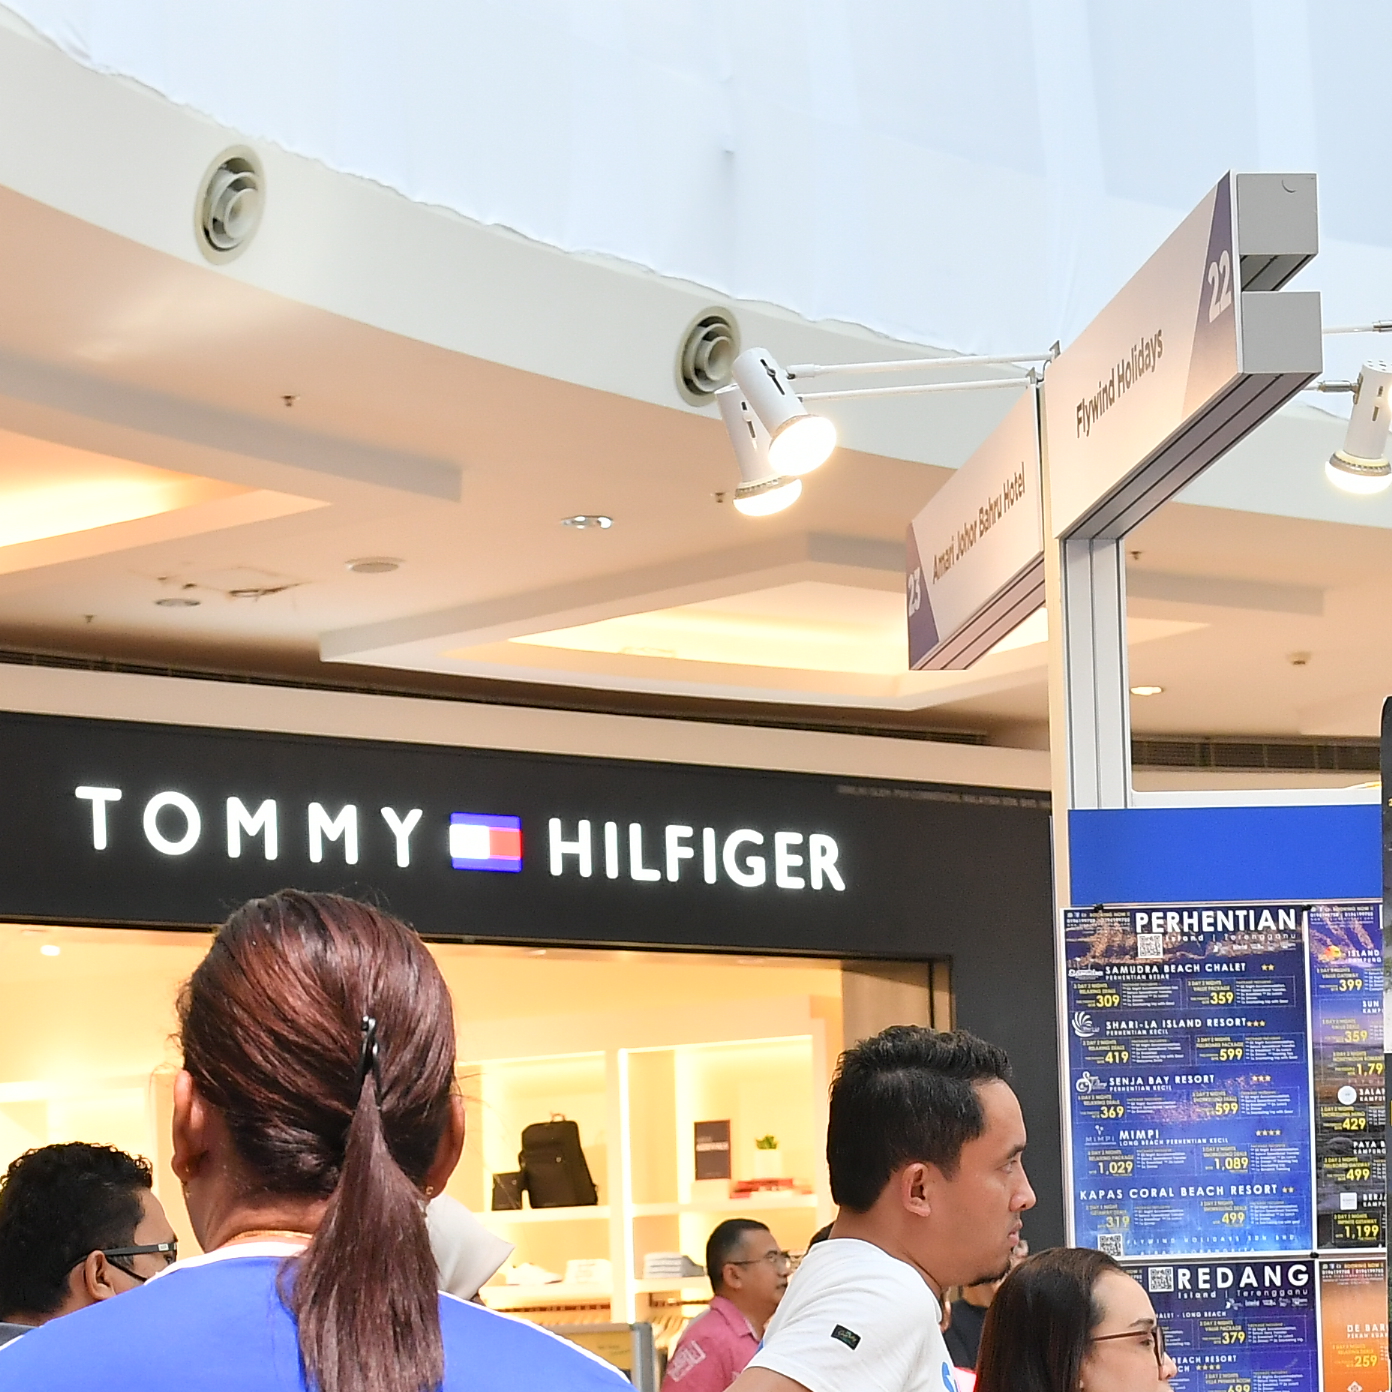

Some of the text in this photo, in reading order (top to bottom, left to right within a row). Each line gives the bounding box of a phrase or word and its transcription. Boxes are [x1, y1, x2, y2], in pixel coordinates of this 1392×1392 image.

[1208, 250, 1232, 323] 22
[1076, 329, 1163, 438] Flywind Holidays
[932, 461, 1025, 584] Amari Johor Bahru Hotel
[908, 567, 921, 617] 23
[75, 785, 847, 893] TOMMY HILFIGER
[1135, 909, 1296, 933] PERHENTIAN
[1106, 963, 1246, 974] SAMUDRA BEACH CHALET
[1339, 980, 1363, 991] 399
[1096, 995, 1120, 1007] 309
[1210, 992, 1234, 1004] 359
[1106, 1018, 1246, 1029] SHARI-LA ISLAND RESORT
[1105, 1052, 1129, 1064] 419
[1219, 1048, 1243, 1060] 599
[1109, 1075, 1215, 1085] SENJA BAY RESORT
[1100, 1106, 1124, 1118] 369
[1215, 1103, 1239, 1115] 599
[1342, 1118, 1366, 1130] 429
[1119, 1130, 1159, 1140] MIMPI
[1098, 1162, 1133, 1174] 1,029
[1214, 1157, 1249, 1170] 1,089
[1346, 1169, 1370, 1181] 499
[1080, 1184, 1278, 1200] KAPAS CORAL BEACH RESORT
[1106, 1216, 1130, 1228] 319
[1221, 1212, 1245, 1224] 499
[1344, 1225, 1379, 1238] 1,199
[1178, 1264, 1309, 1290] REDANG
[1237, 1288, 1308, 1297] Terengganu
[1222, 1332, 1245, 1344] 379
